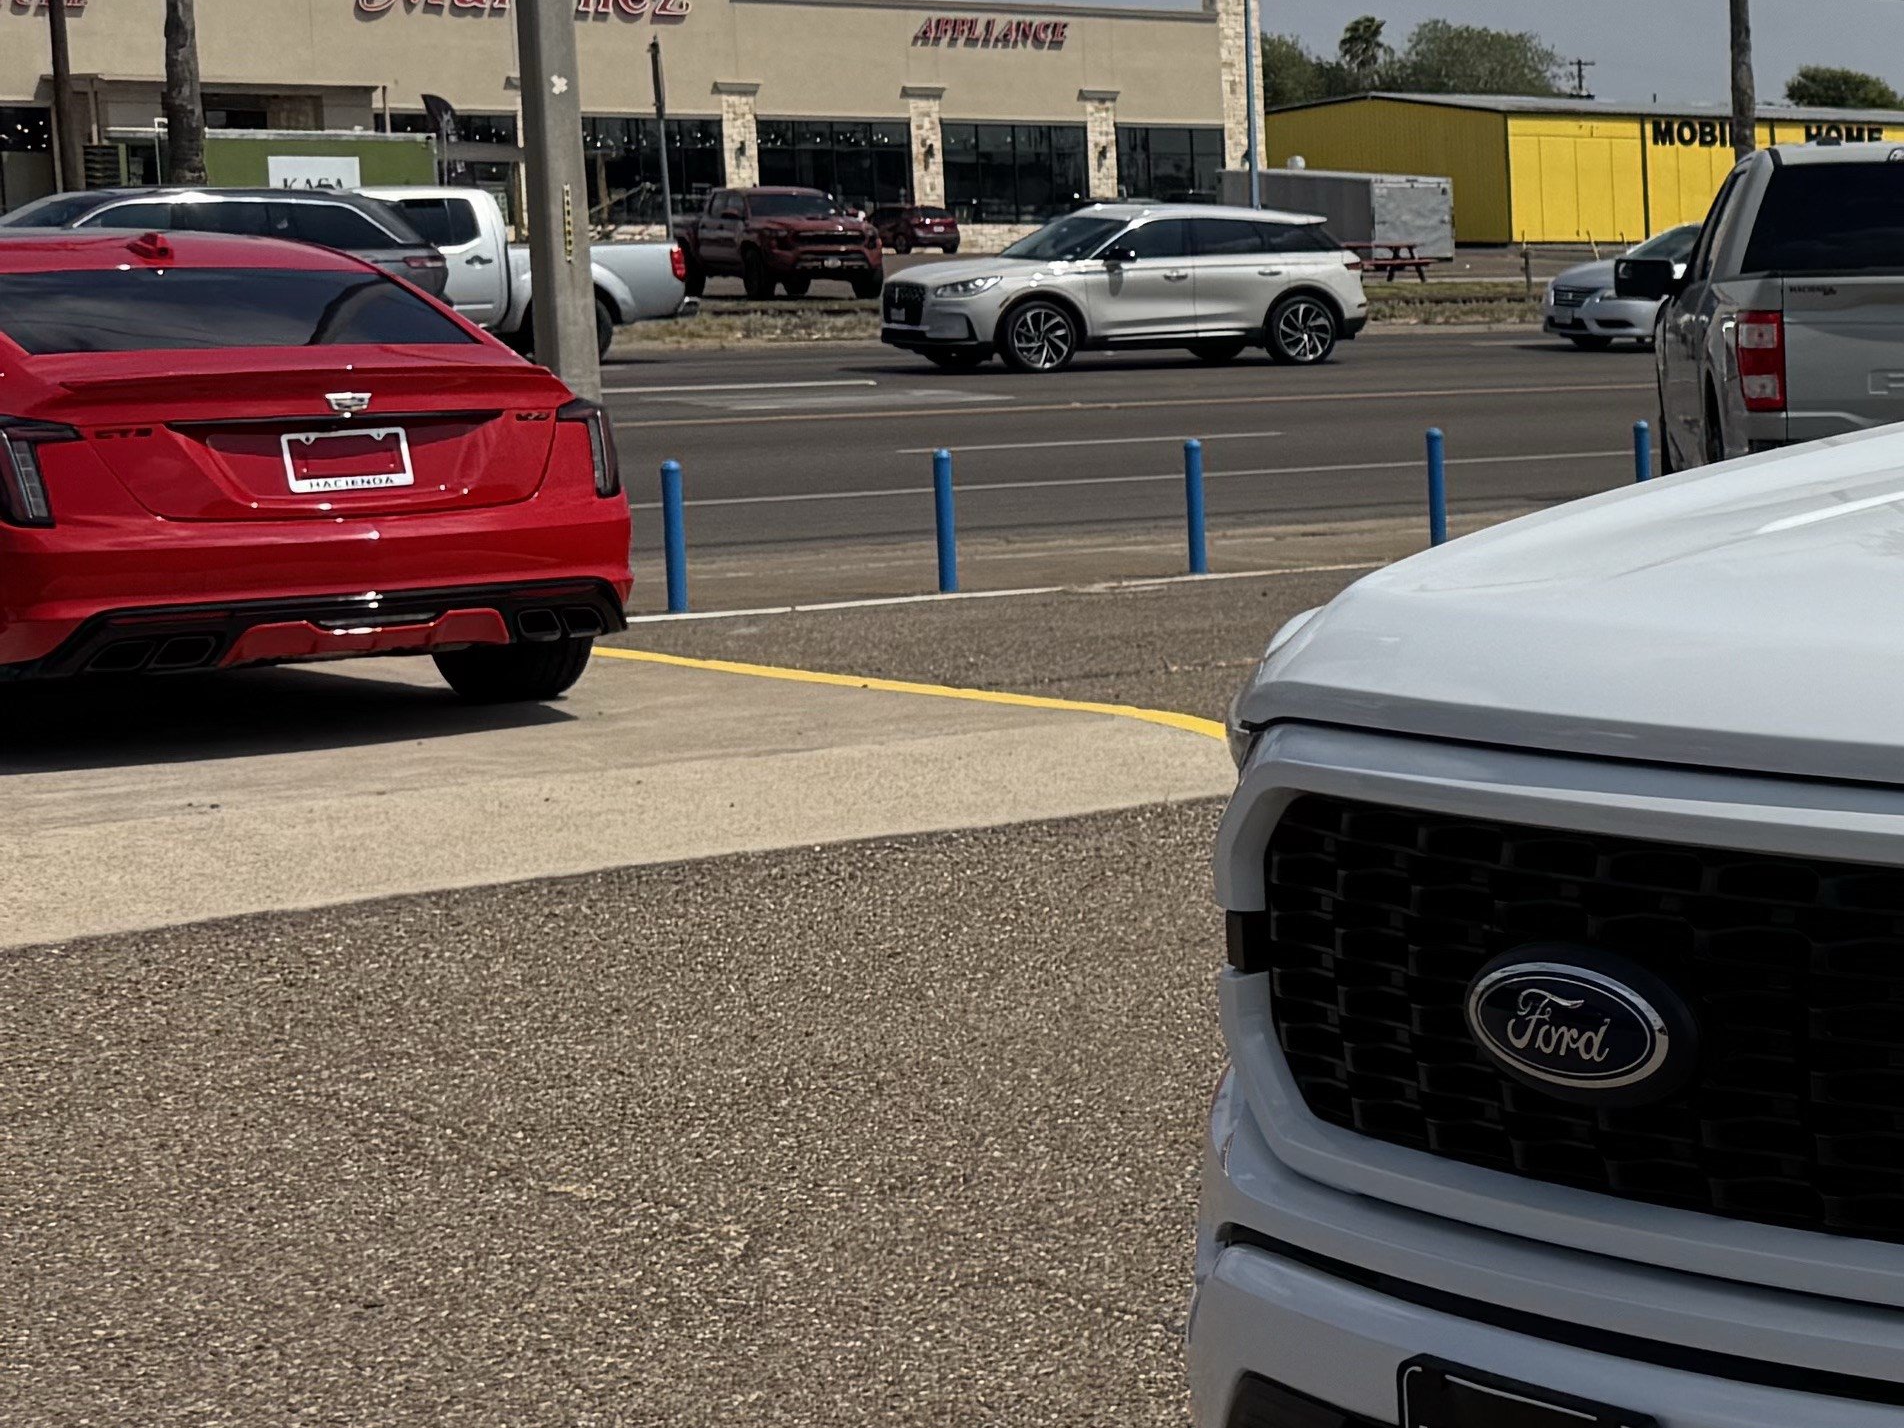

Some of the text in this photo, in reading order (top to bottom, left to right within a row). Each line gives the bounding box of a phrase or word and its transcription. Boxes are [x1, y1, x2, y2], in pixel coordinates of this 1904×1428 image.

[914, 16, 1069, 43] APPLIANCE
[1651, 120, 1734, 148] MOBI
[309, 476, 395, 489] HACIENDA
[1506, 987, 1612, 1063] Ford
